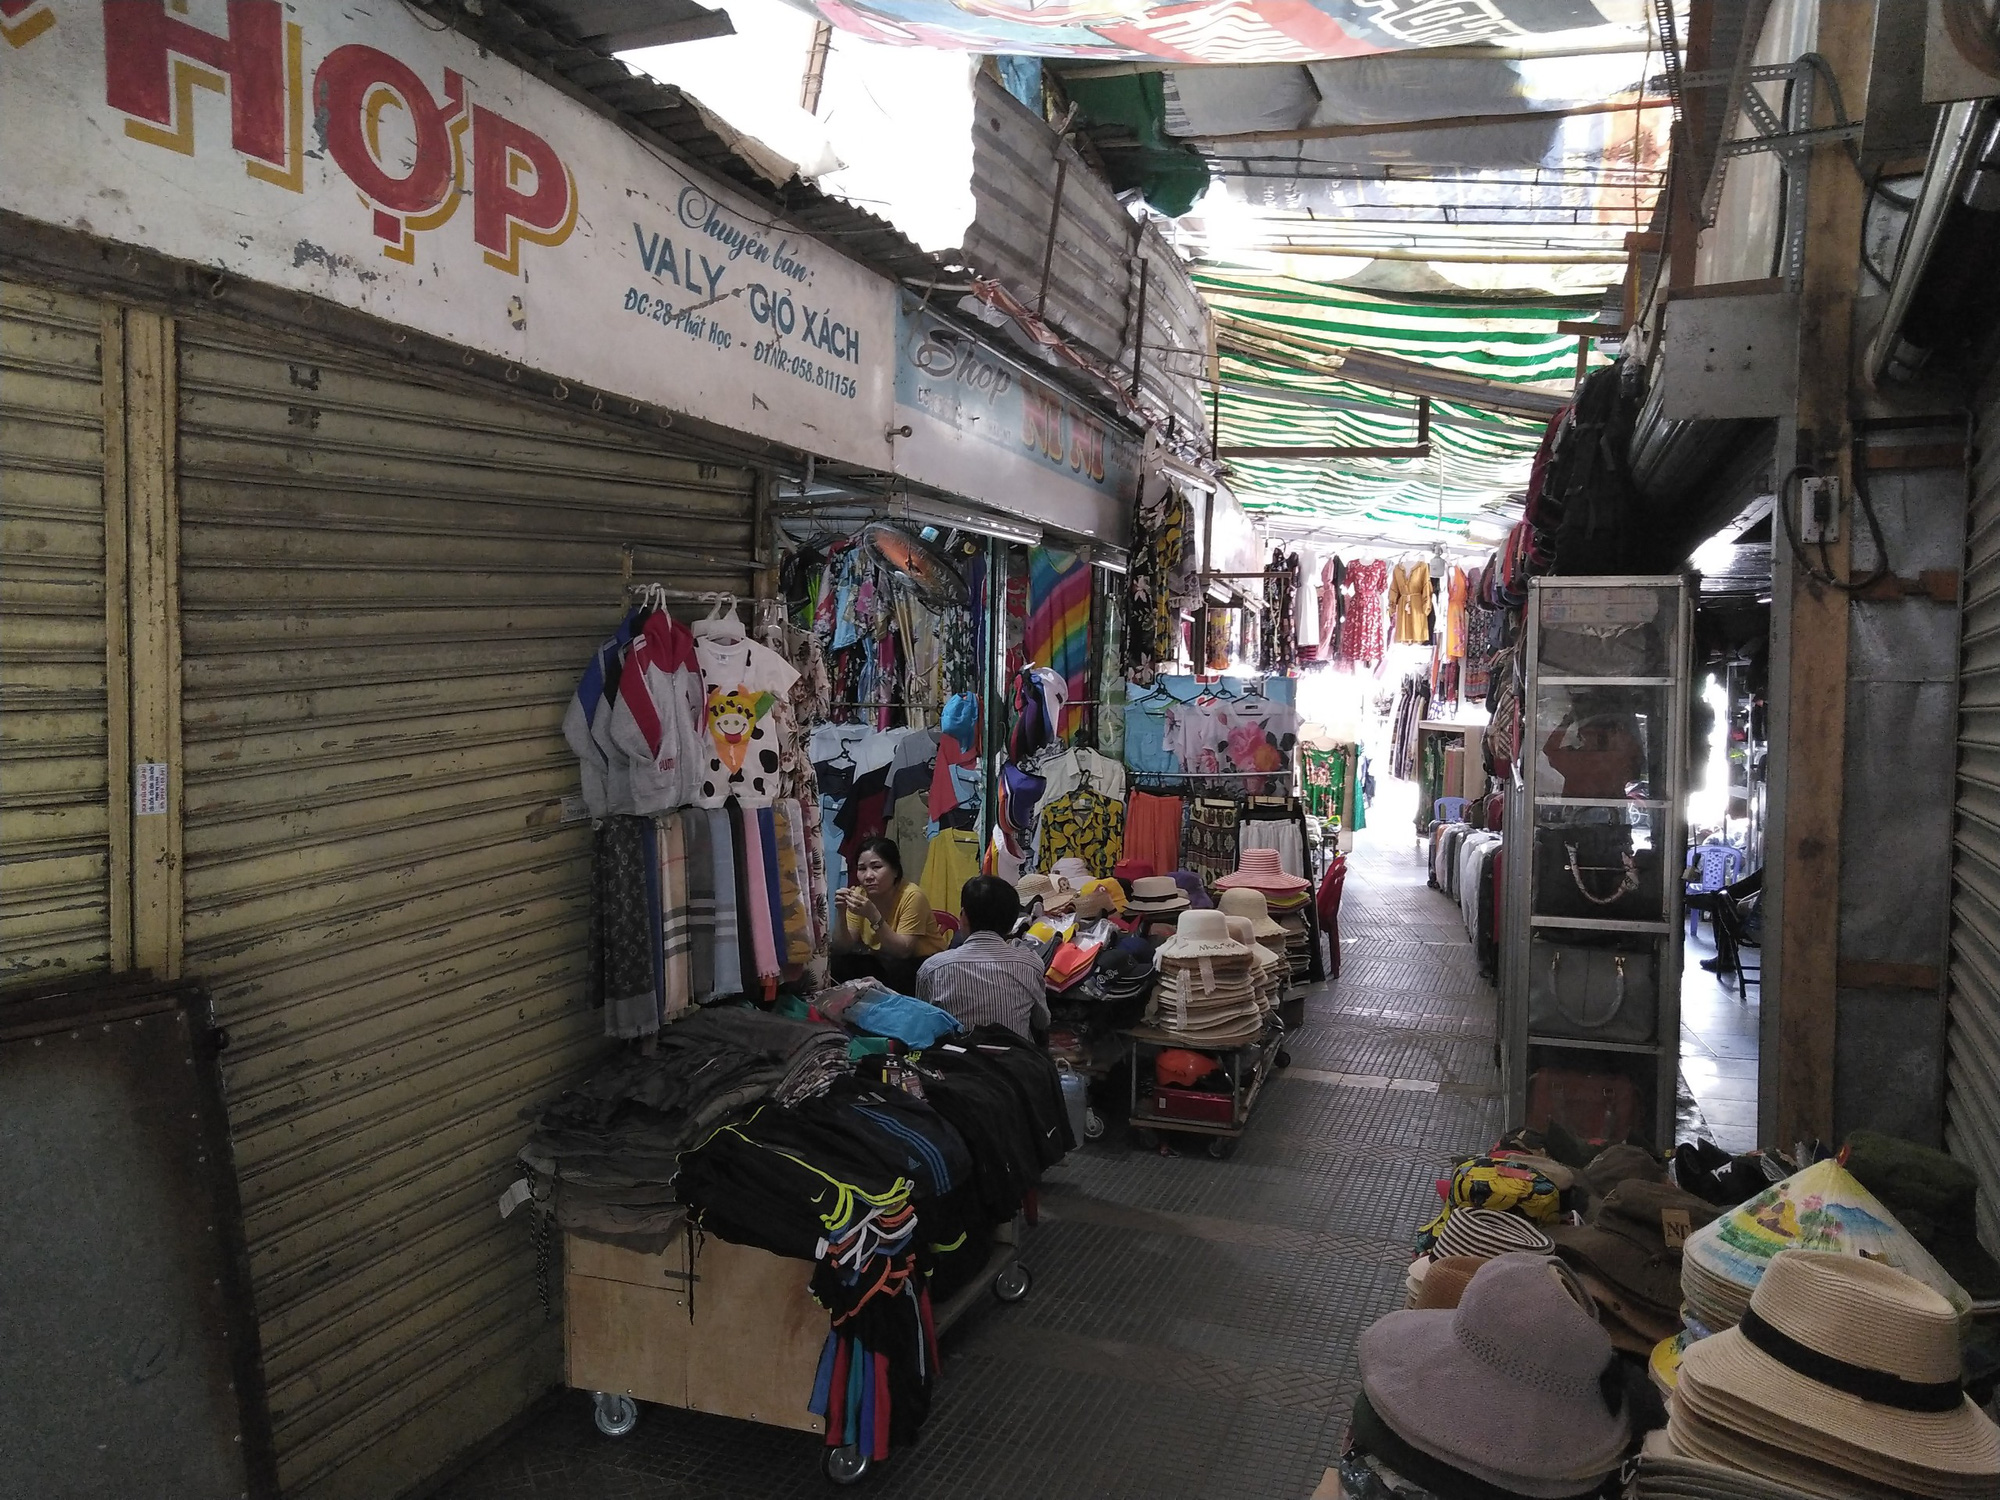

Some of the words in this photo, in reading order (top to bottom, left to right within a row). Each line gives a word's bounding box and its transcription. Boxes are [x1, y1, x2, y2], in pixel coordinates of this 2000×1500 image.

[677, 185, 770, 261] Chuyên
[772, 238, 815, 288] bán:
[632, 221, 726, 302] VALY
[749, 283, 796, 335] GIỎ
[801, 303, 860, 365] XÁCH
[708, 321, 732, 351] Học
[907, 328, 1013, 408] Shop
